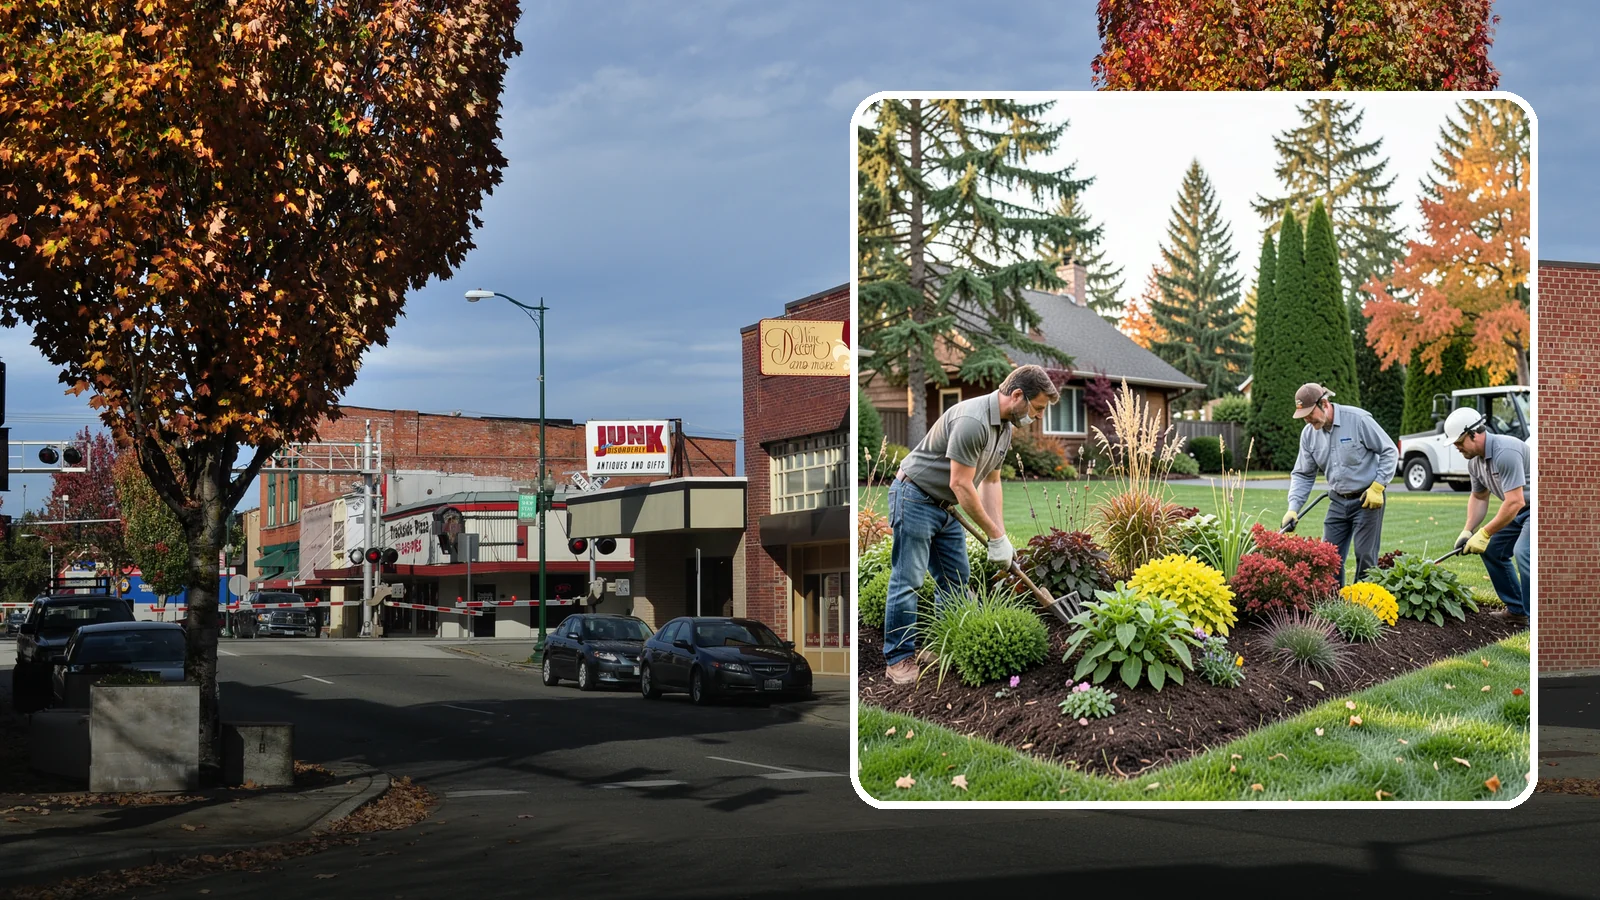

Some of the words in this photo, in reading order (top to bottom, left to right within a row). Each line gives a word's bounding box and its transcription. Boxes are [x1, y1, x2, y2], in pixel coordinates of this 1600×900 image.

[595, 425, 665, 457] JUNK
[607, 446, 646, 454] DISORDERLY
[597, 461, 628, 470] ANTIQUES
[631, 461, 644, 470] AND
[647, 460, 665, 469] GIFTS
[573, 473, 588, 490] RAIL
[390, 521, 412, 539] Trackside
[414, 519, 429, 534] Pizza
